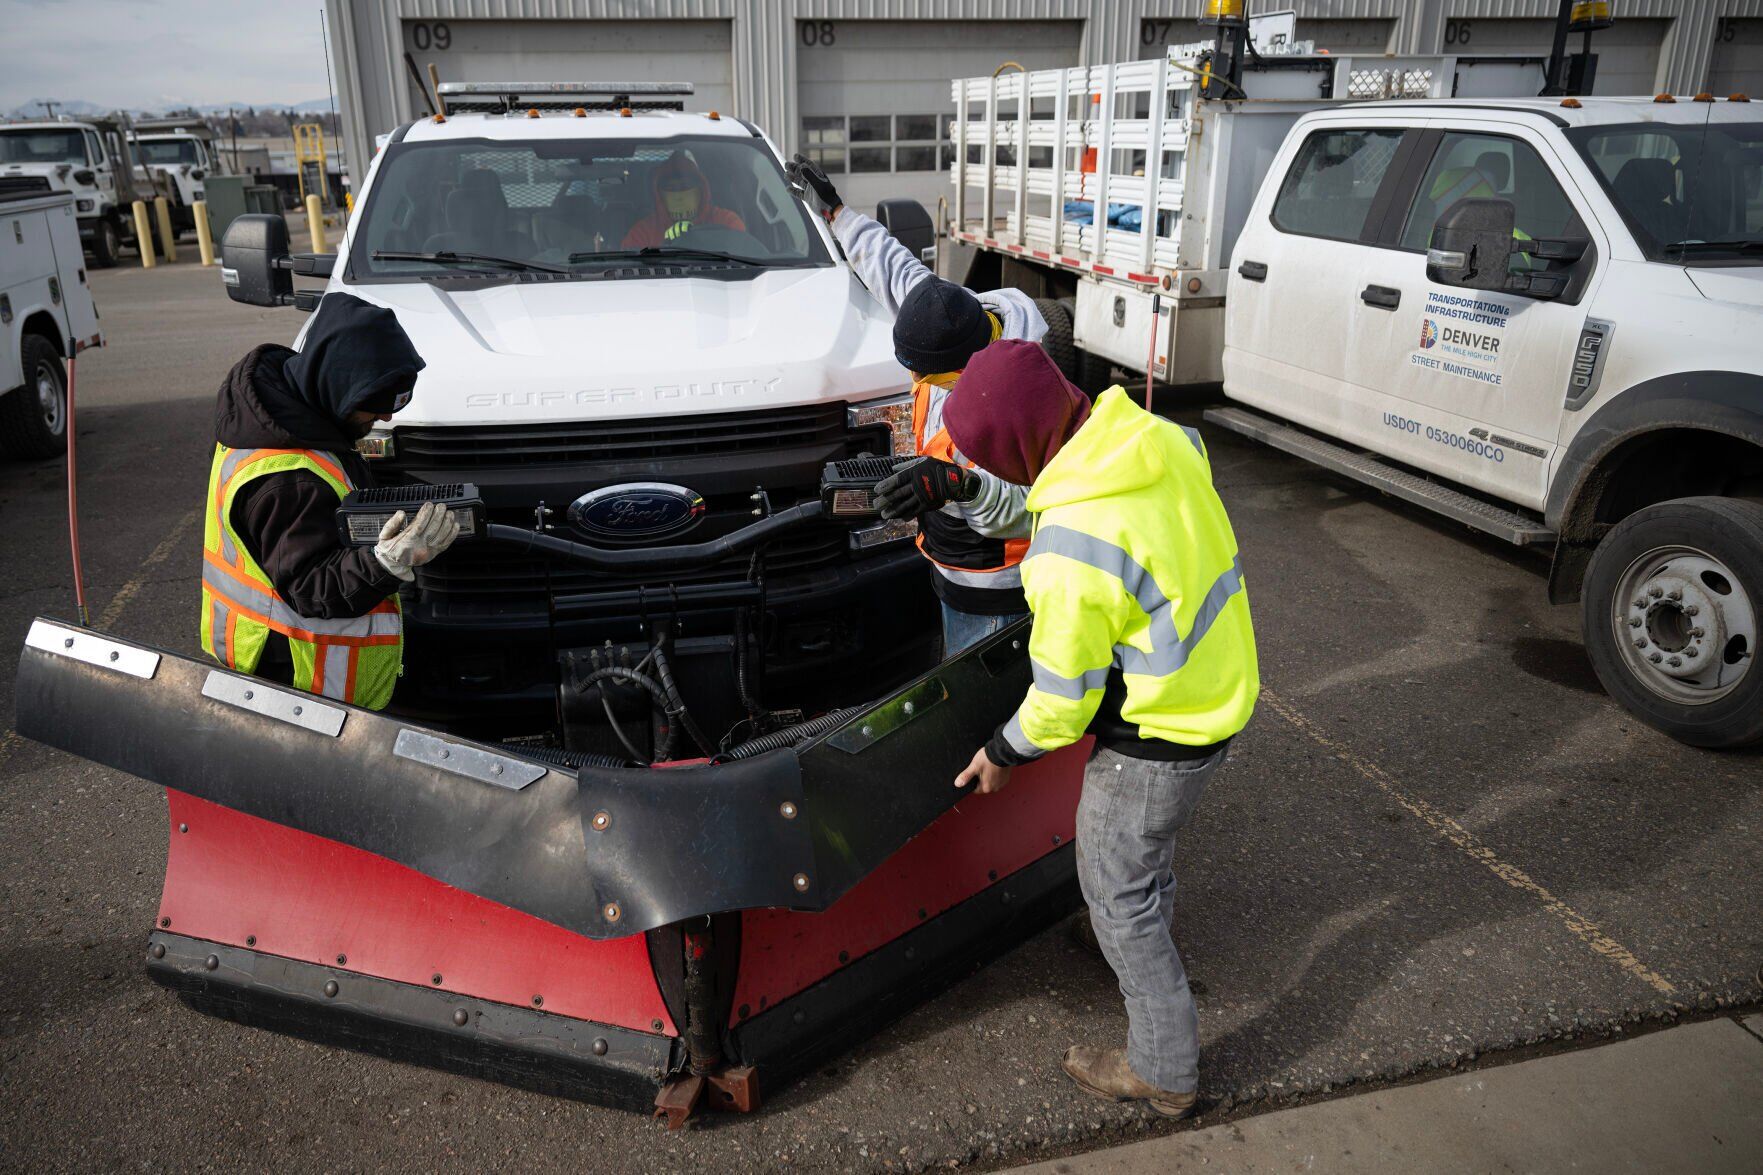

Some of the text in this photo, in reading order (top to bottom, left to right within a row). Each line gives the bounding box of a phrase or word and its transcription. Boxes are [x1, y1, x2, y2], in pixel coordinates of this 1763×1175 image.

[413, 23, 452, 50] 09
[802, 20, 835, 47] 08
[1141, 20, 1172, 46] 07
[1445, 21, 1471, 45] 06
[1425, 303, 1507, 328] INFRASTRUCTURE
[1441, 344, 1498, 363] THE MILE HIGH CITY
[1442, 327, 1500, 353] DENVER
[1411, 354, 1502, 385] STREET MAINTENANCE
[466, 377, 785, 409] SUPER DUTY
[1383, 412, 1422, 435] USDOT
[1426, 426, 1505, 463] 0530060CO
[607, 497, 669, 525] Ford
